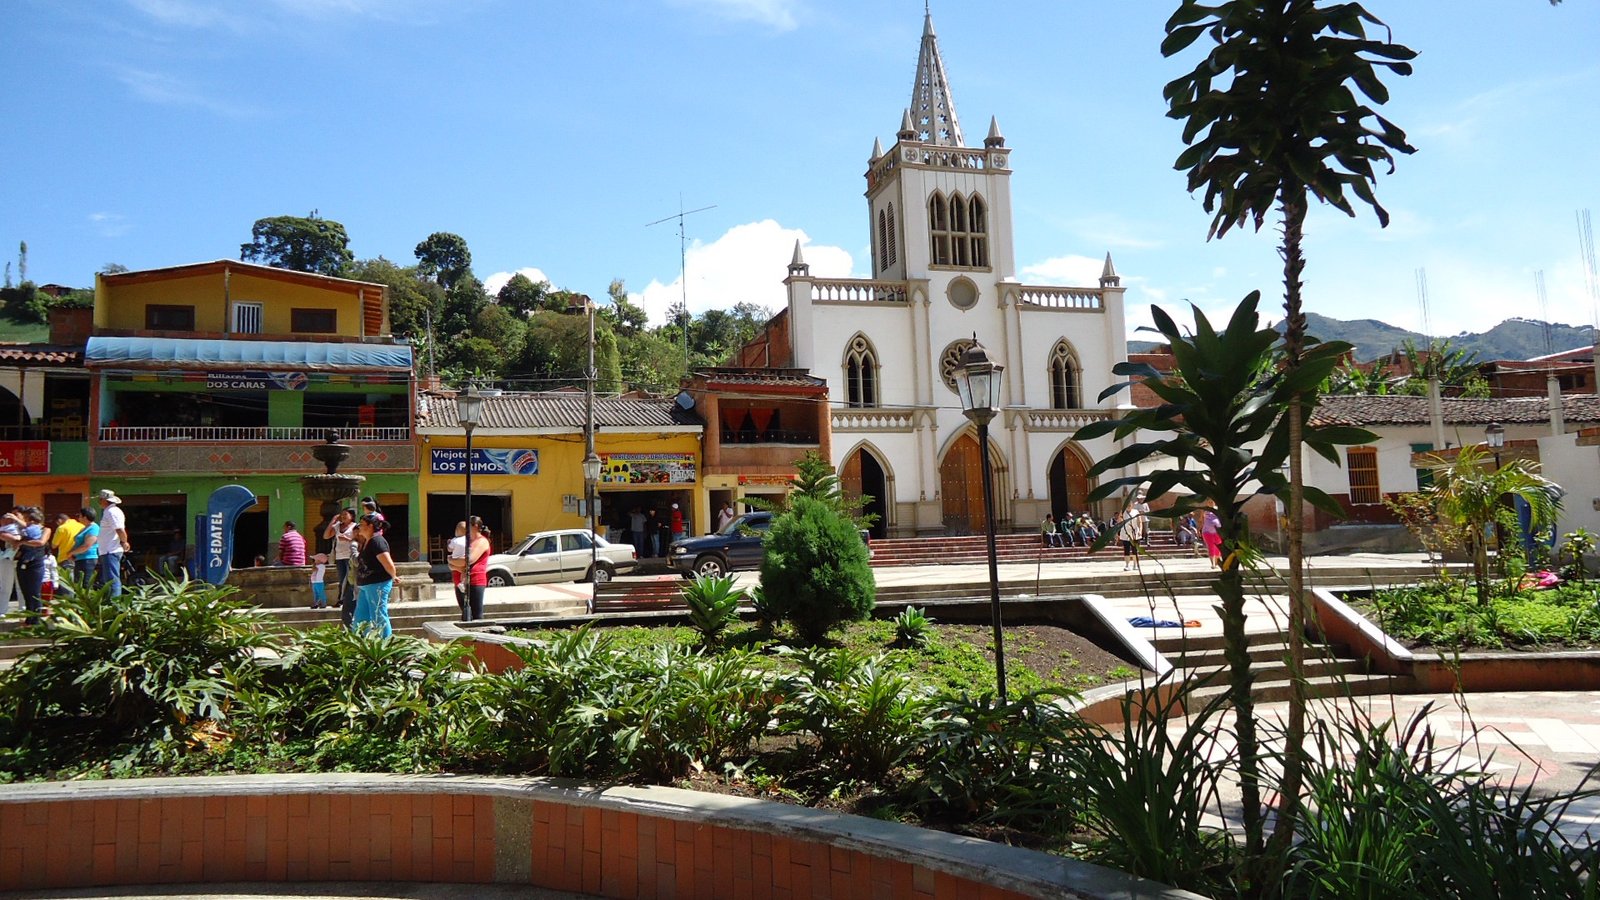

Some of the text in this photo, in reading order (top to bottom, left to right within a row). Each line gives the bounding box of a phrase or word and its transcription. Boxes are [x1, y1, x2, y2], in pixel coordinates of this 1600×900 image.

[206, 381, 266, 389] DOS CARAS
[432, 462, 457, 471] LOS
[210, 512, 223, 555] EDATEL
